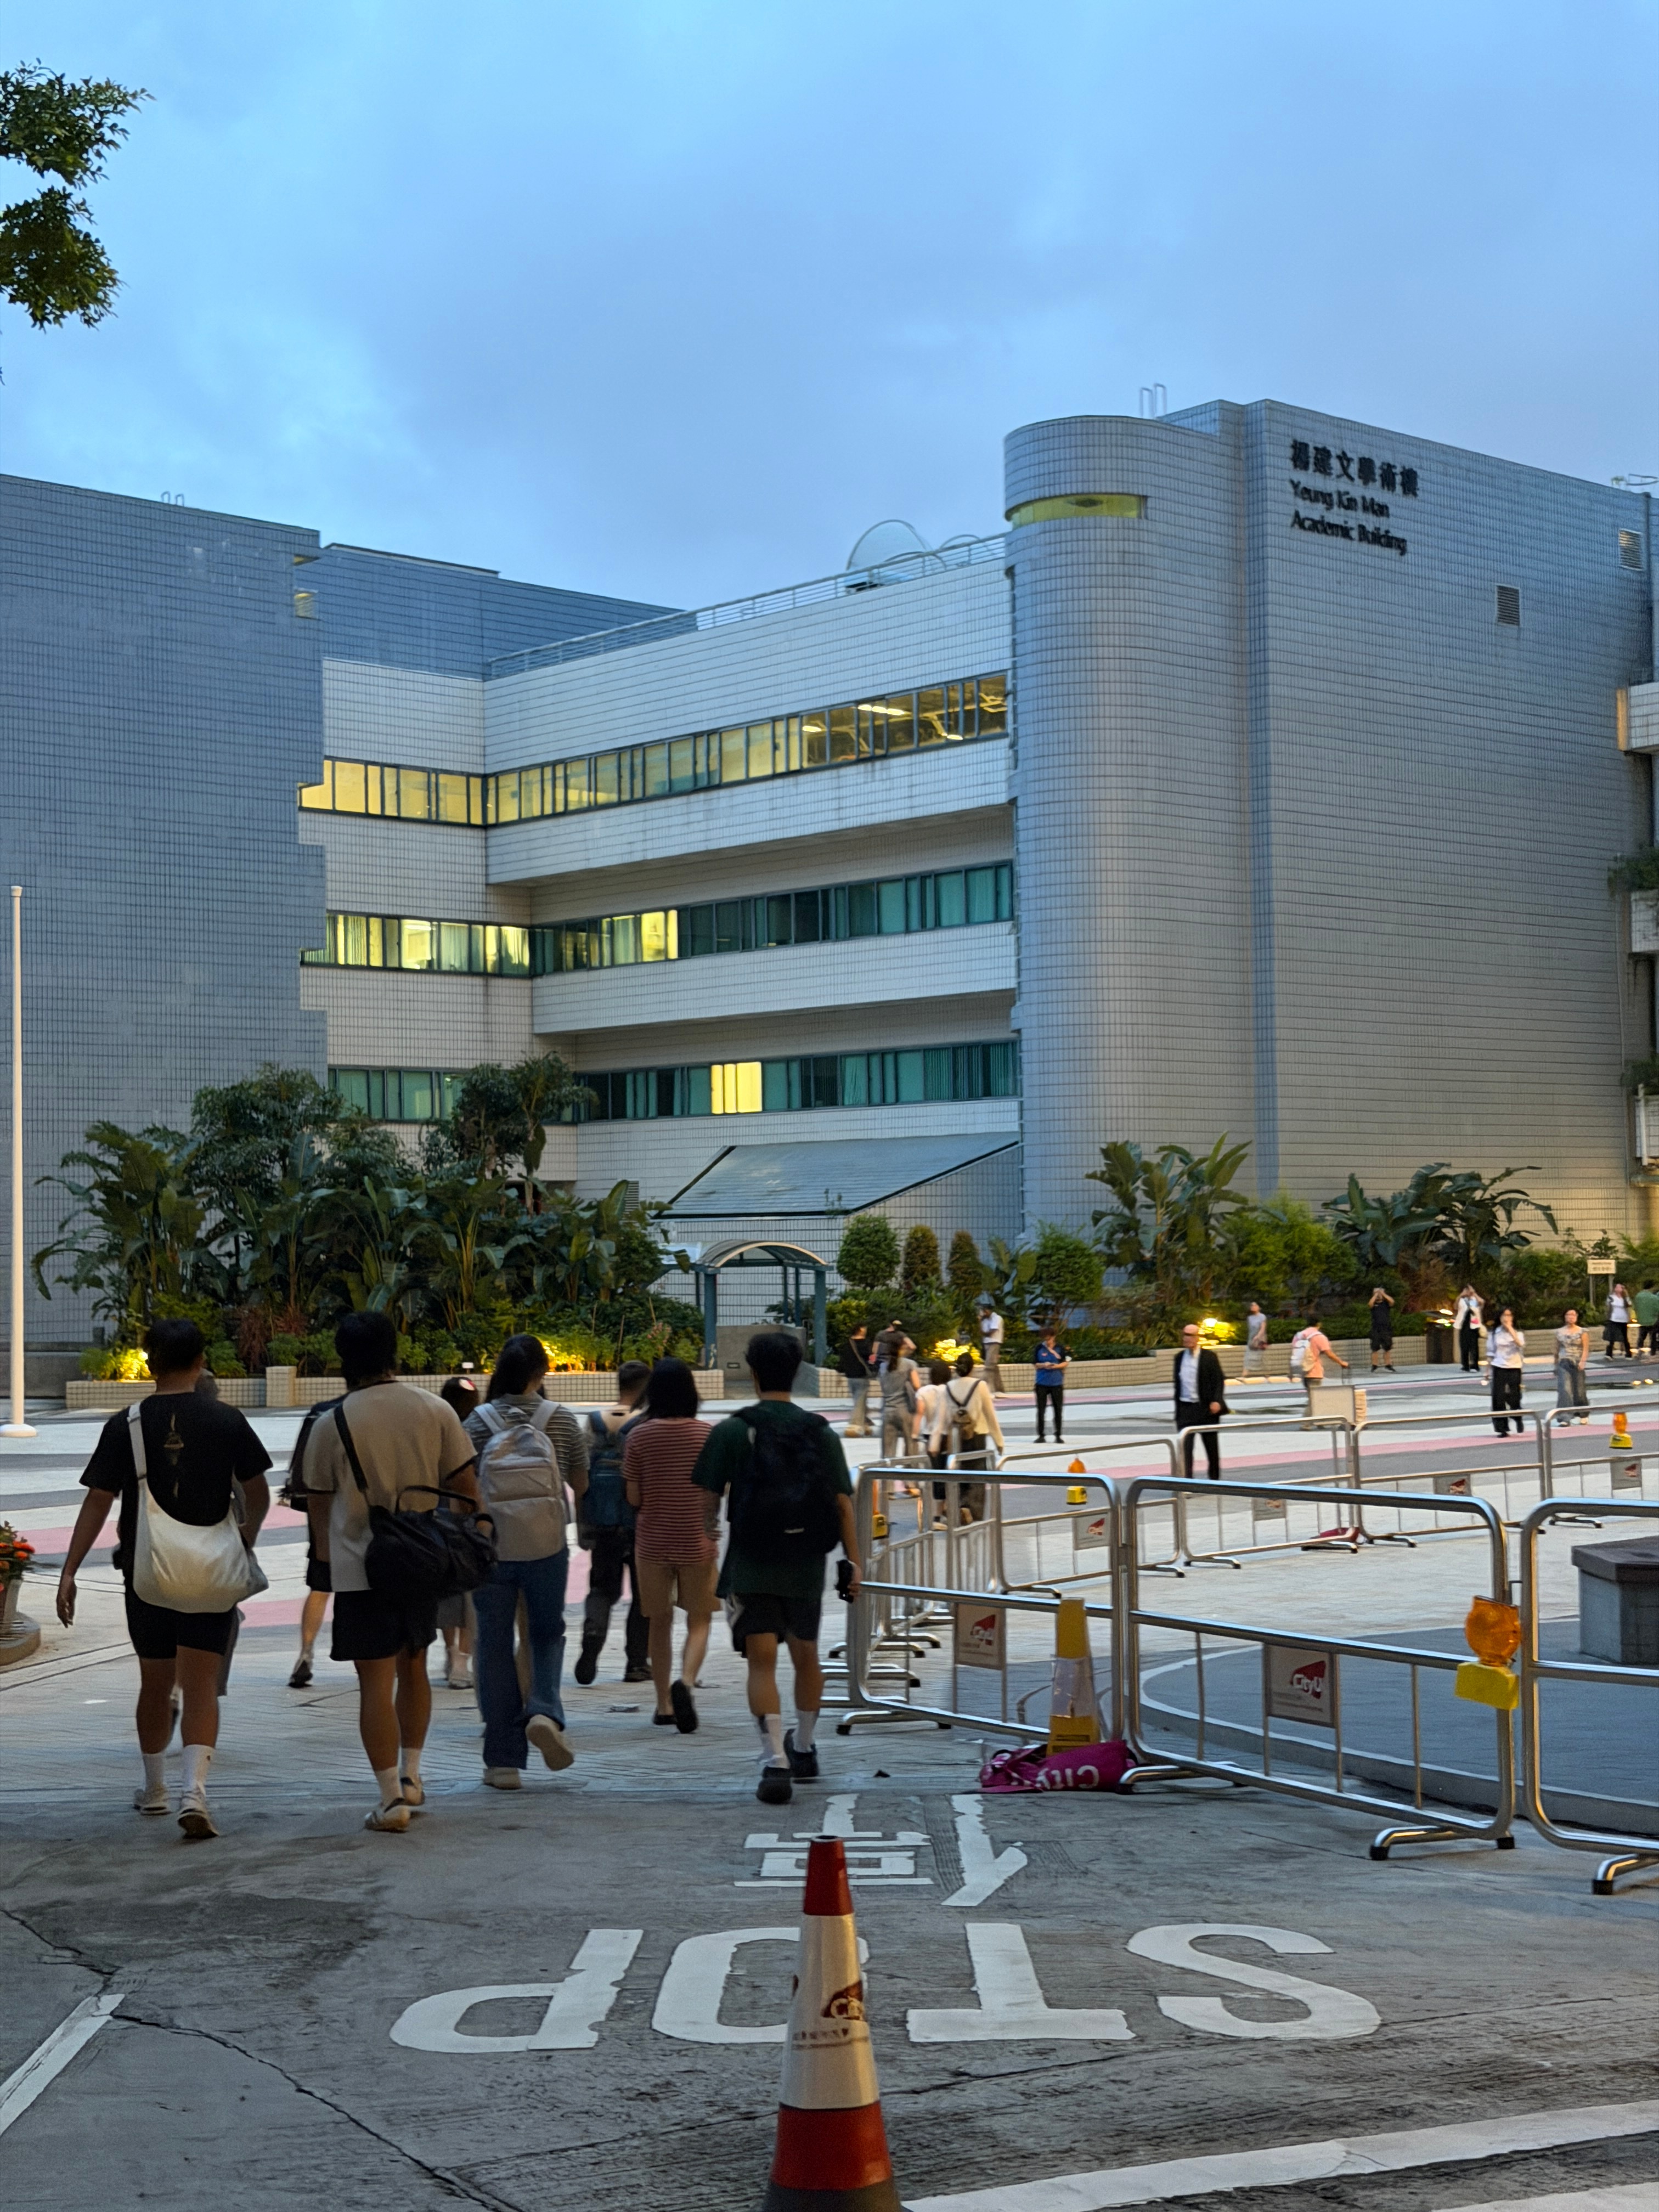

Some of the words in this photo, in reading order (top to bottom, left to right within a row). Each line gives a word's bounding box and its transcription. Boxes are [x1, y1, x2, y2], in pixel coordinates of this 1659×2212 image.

[1290, 478, 1334, 511] Yeung
[1336, 489, 1358, 512] Kin
[1362, 495, 1390, 518] Man
[1291, 510, 1355, 540] Academic
[1358, 523, 1407, 556] Building
[389, 1923, 1383, 2053] STOP
